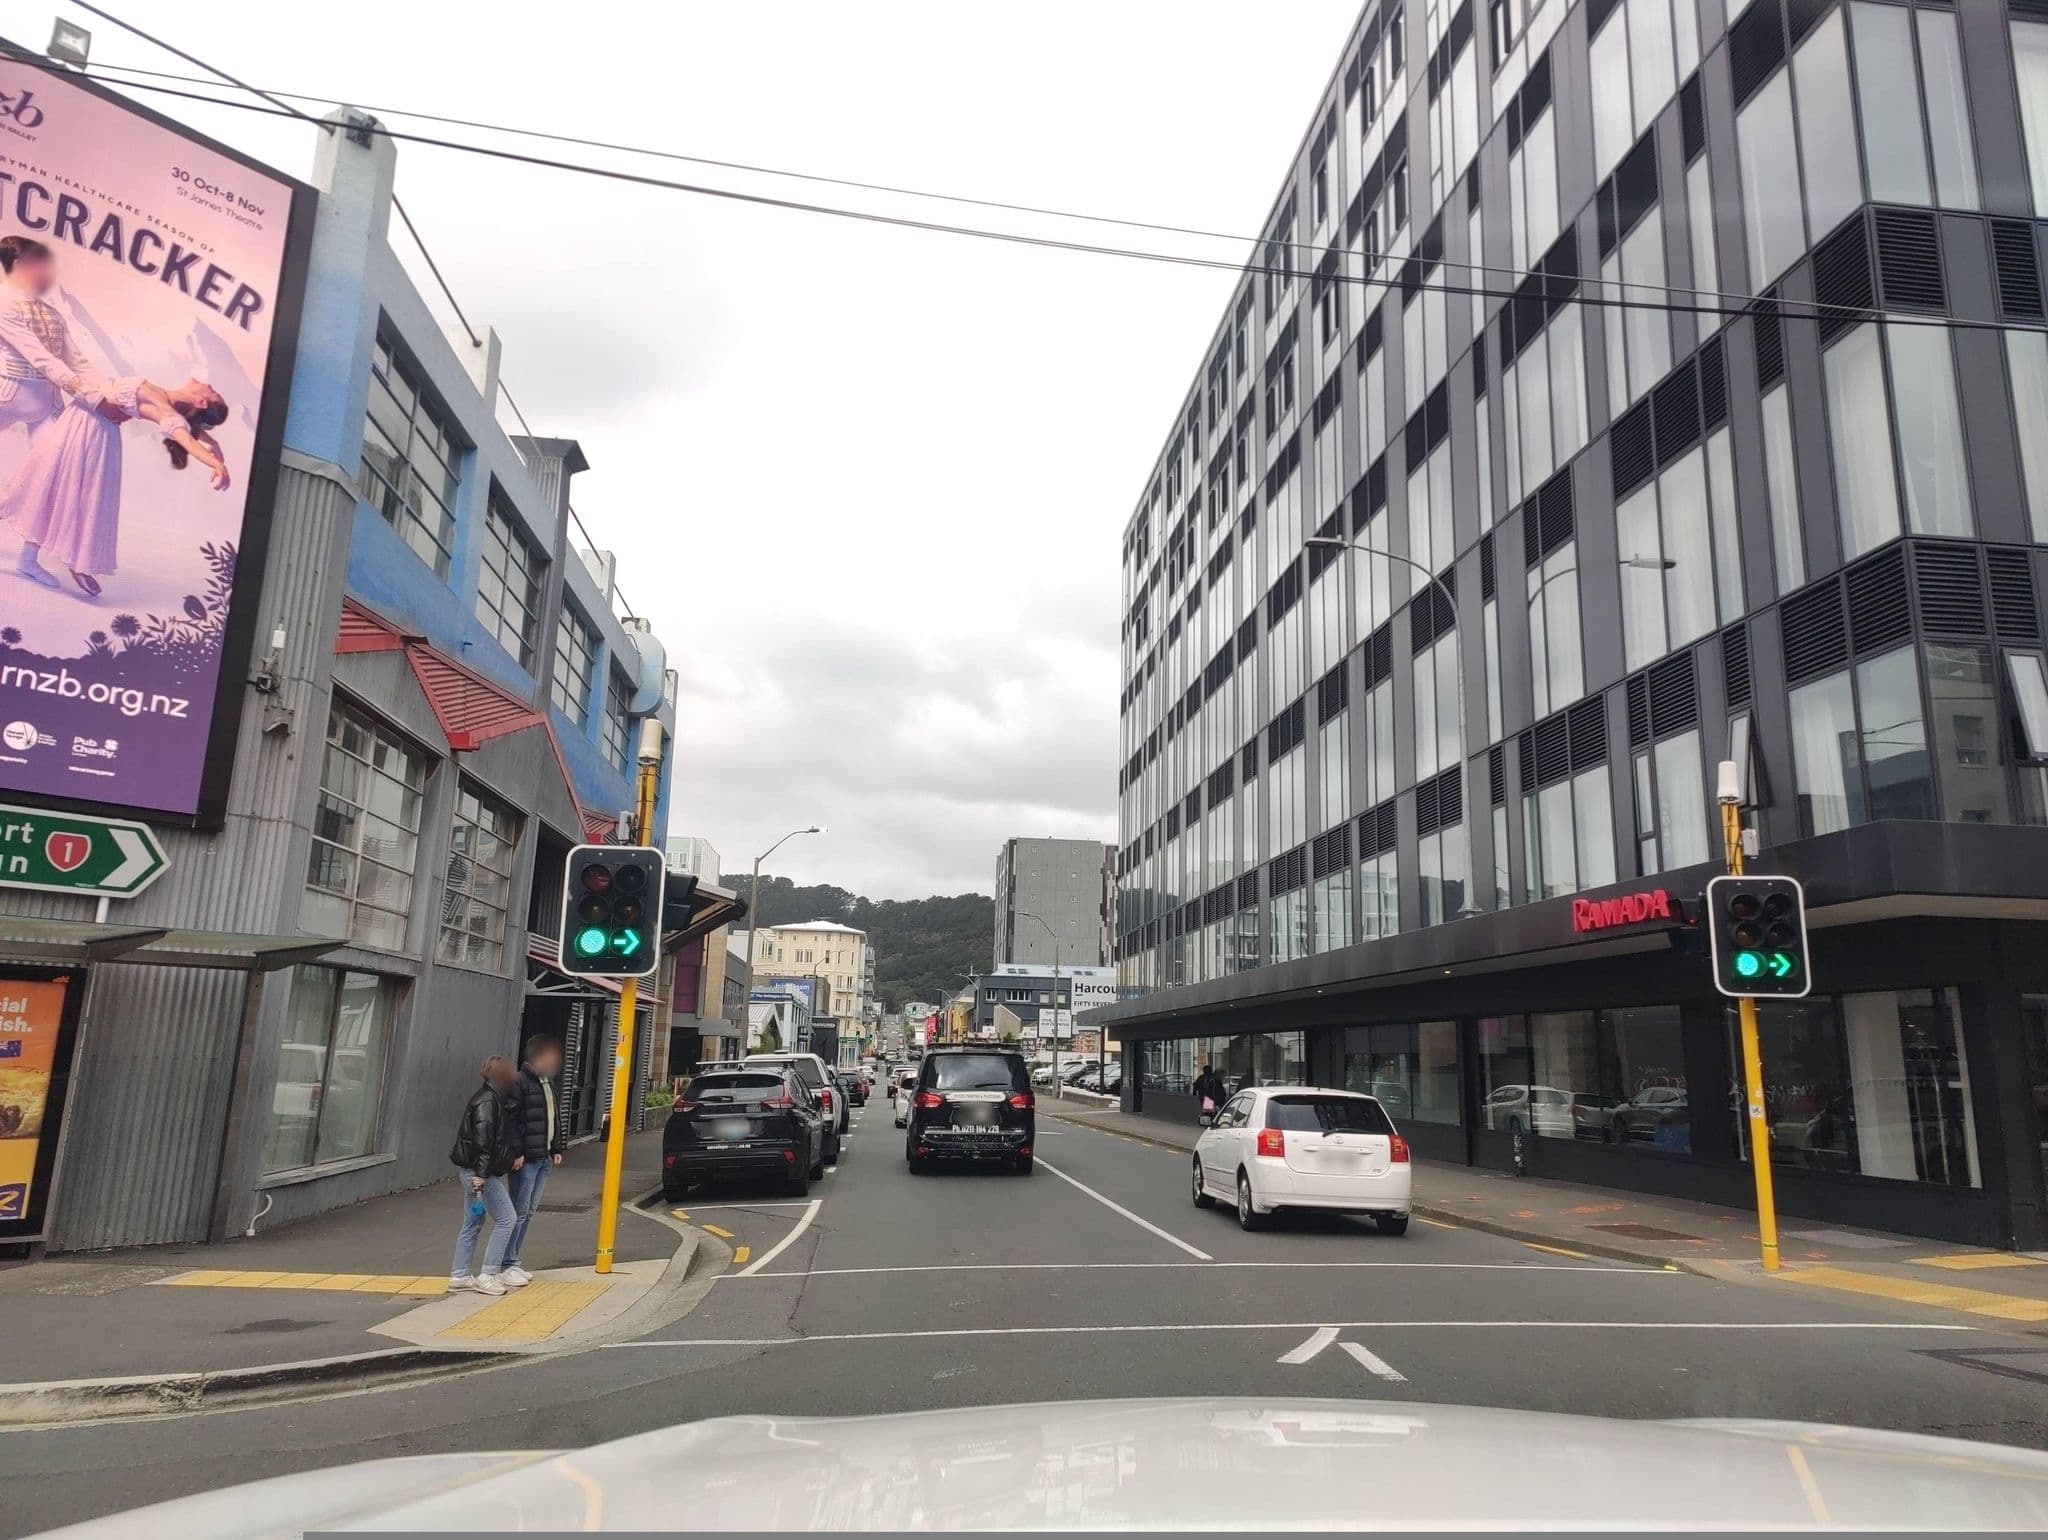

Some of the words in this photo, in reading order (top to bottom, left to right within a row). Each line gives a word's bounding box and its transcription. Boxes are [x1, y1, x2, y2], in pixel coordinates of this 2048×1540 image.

[171, 166, 190, 182] 30
[238, 196, 265, 215] Nov
[176, 186, 188, 197] St
[190, 193, 222, 213] James
[225, 207, 263, 231] Theatre
[55, 174, 140, 216] HEALTHCARE
[146, 214, 195, 243] SEASON
[200, 243, 215, 253] OF
[0, 664, 189, 718] rnzb.org.nz
[73, 735, 98, 748] Pub
[0, 822, 35, 844] rt
[64, 841, 73, 863] 1
[1572, 889, 1671, 932] RAMADA
[0, 997, 28, 1013] ial
